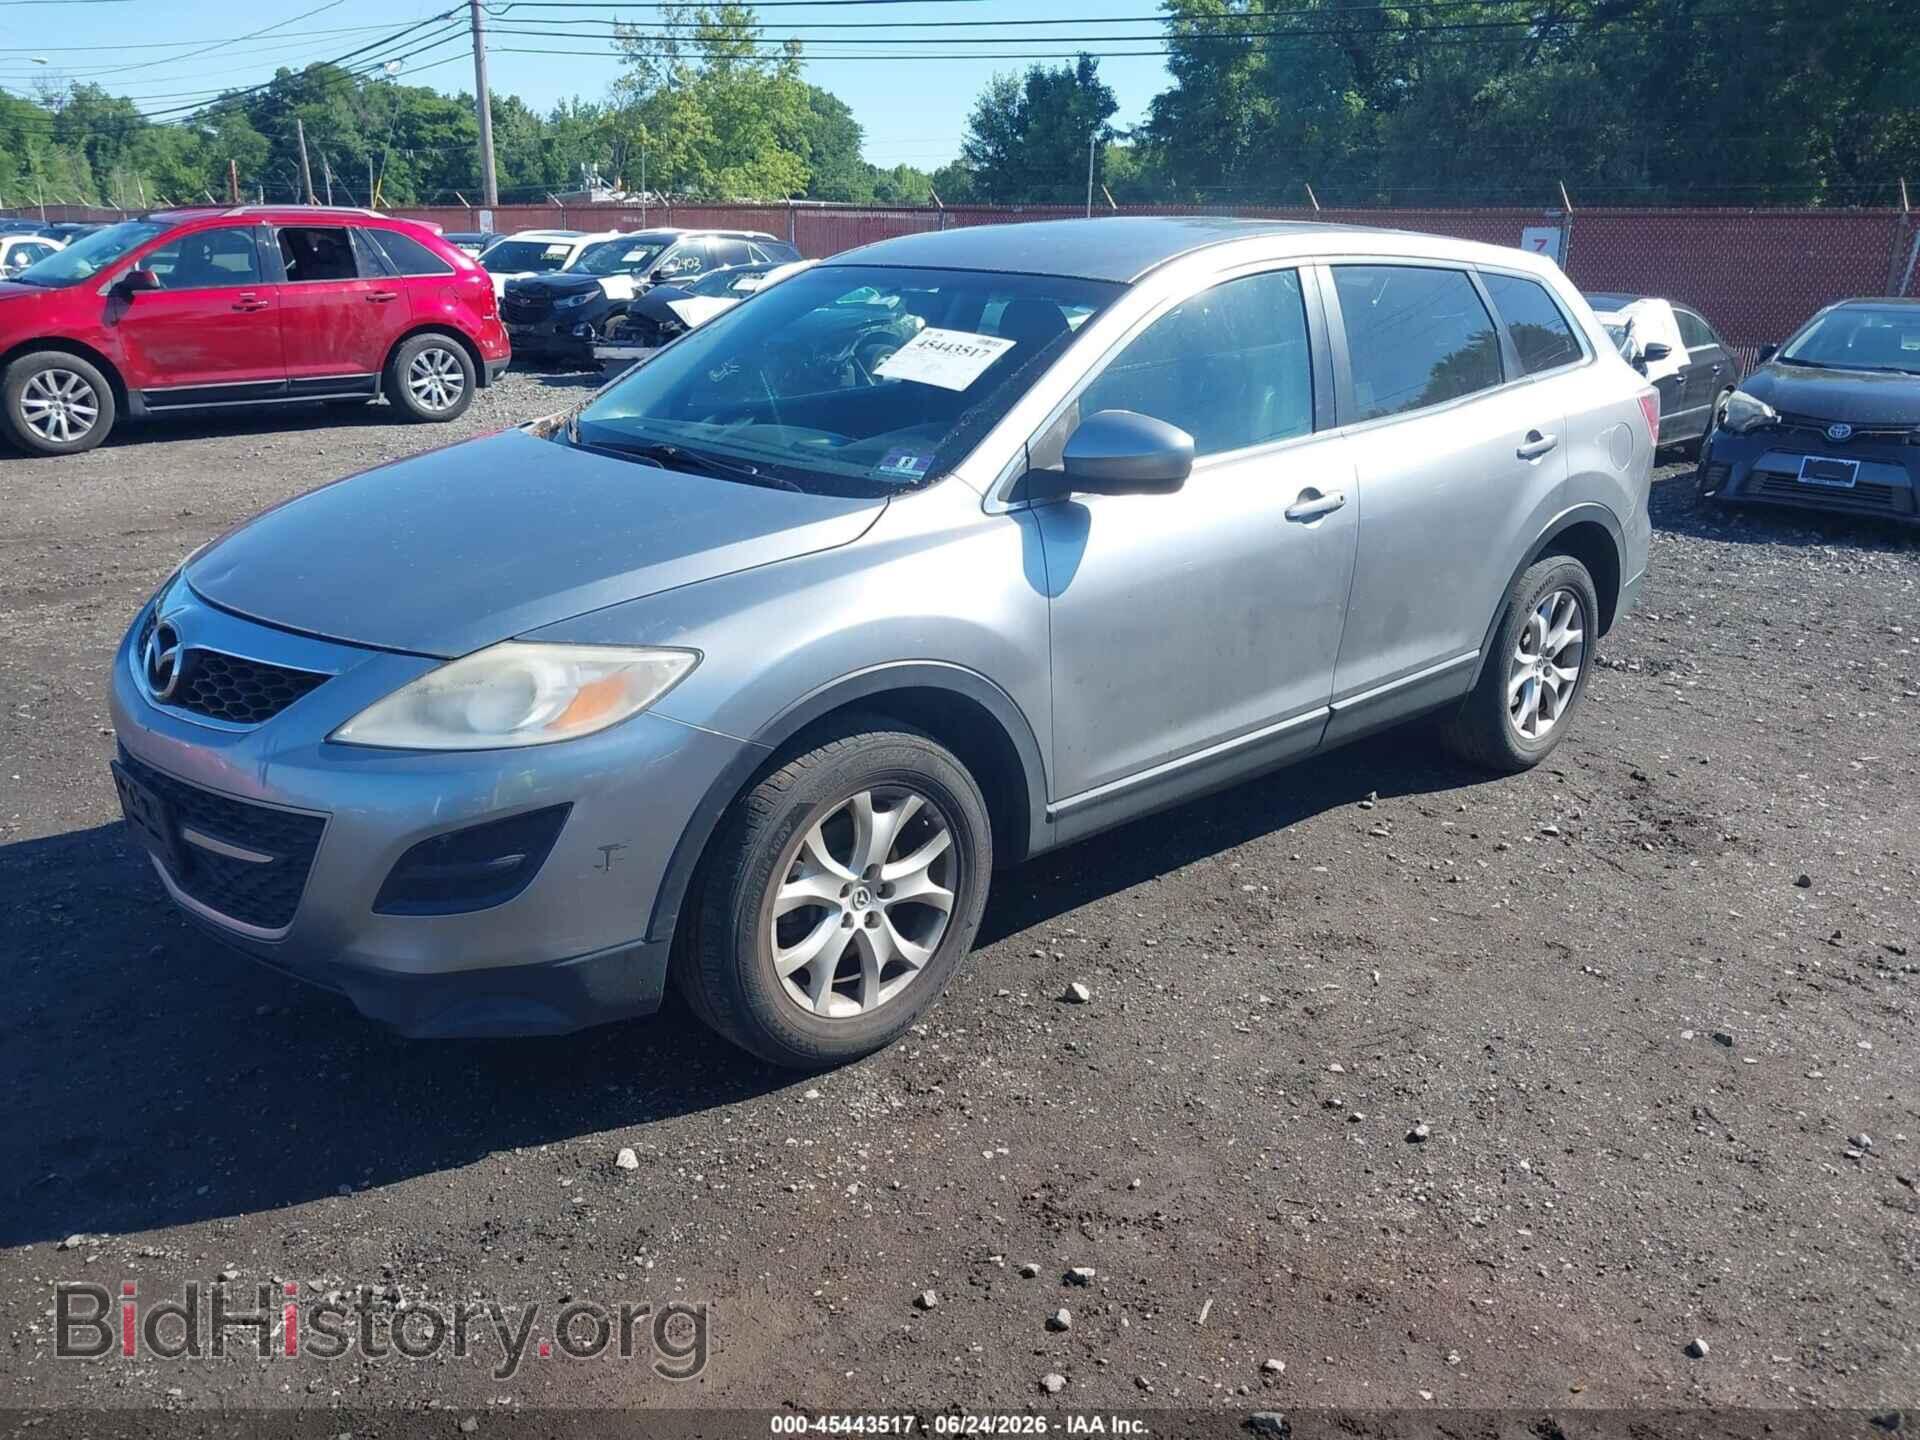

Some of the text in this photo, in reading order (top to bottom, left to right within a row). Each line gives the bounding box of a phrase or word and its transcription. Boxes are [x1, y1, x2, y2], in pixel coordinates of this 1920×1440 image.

[1533, 238, 1549, 252] 7
[672, 256, 702, 273] 2403
[916, 339, 992, 358] 45443517
